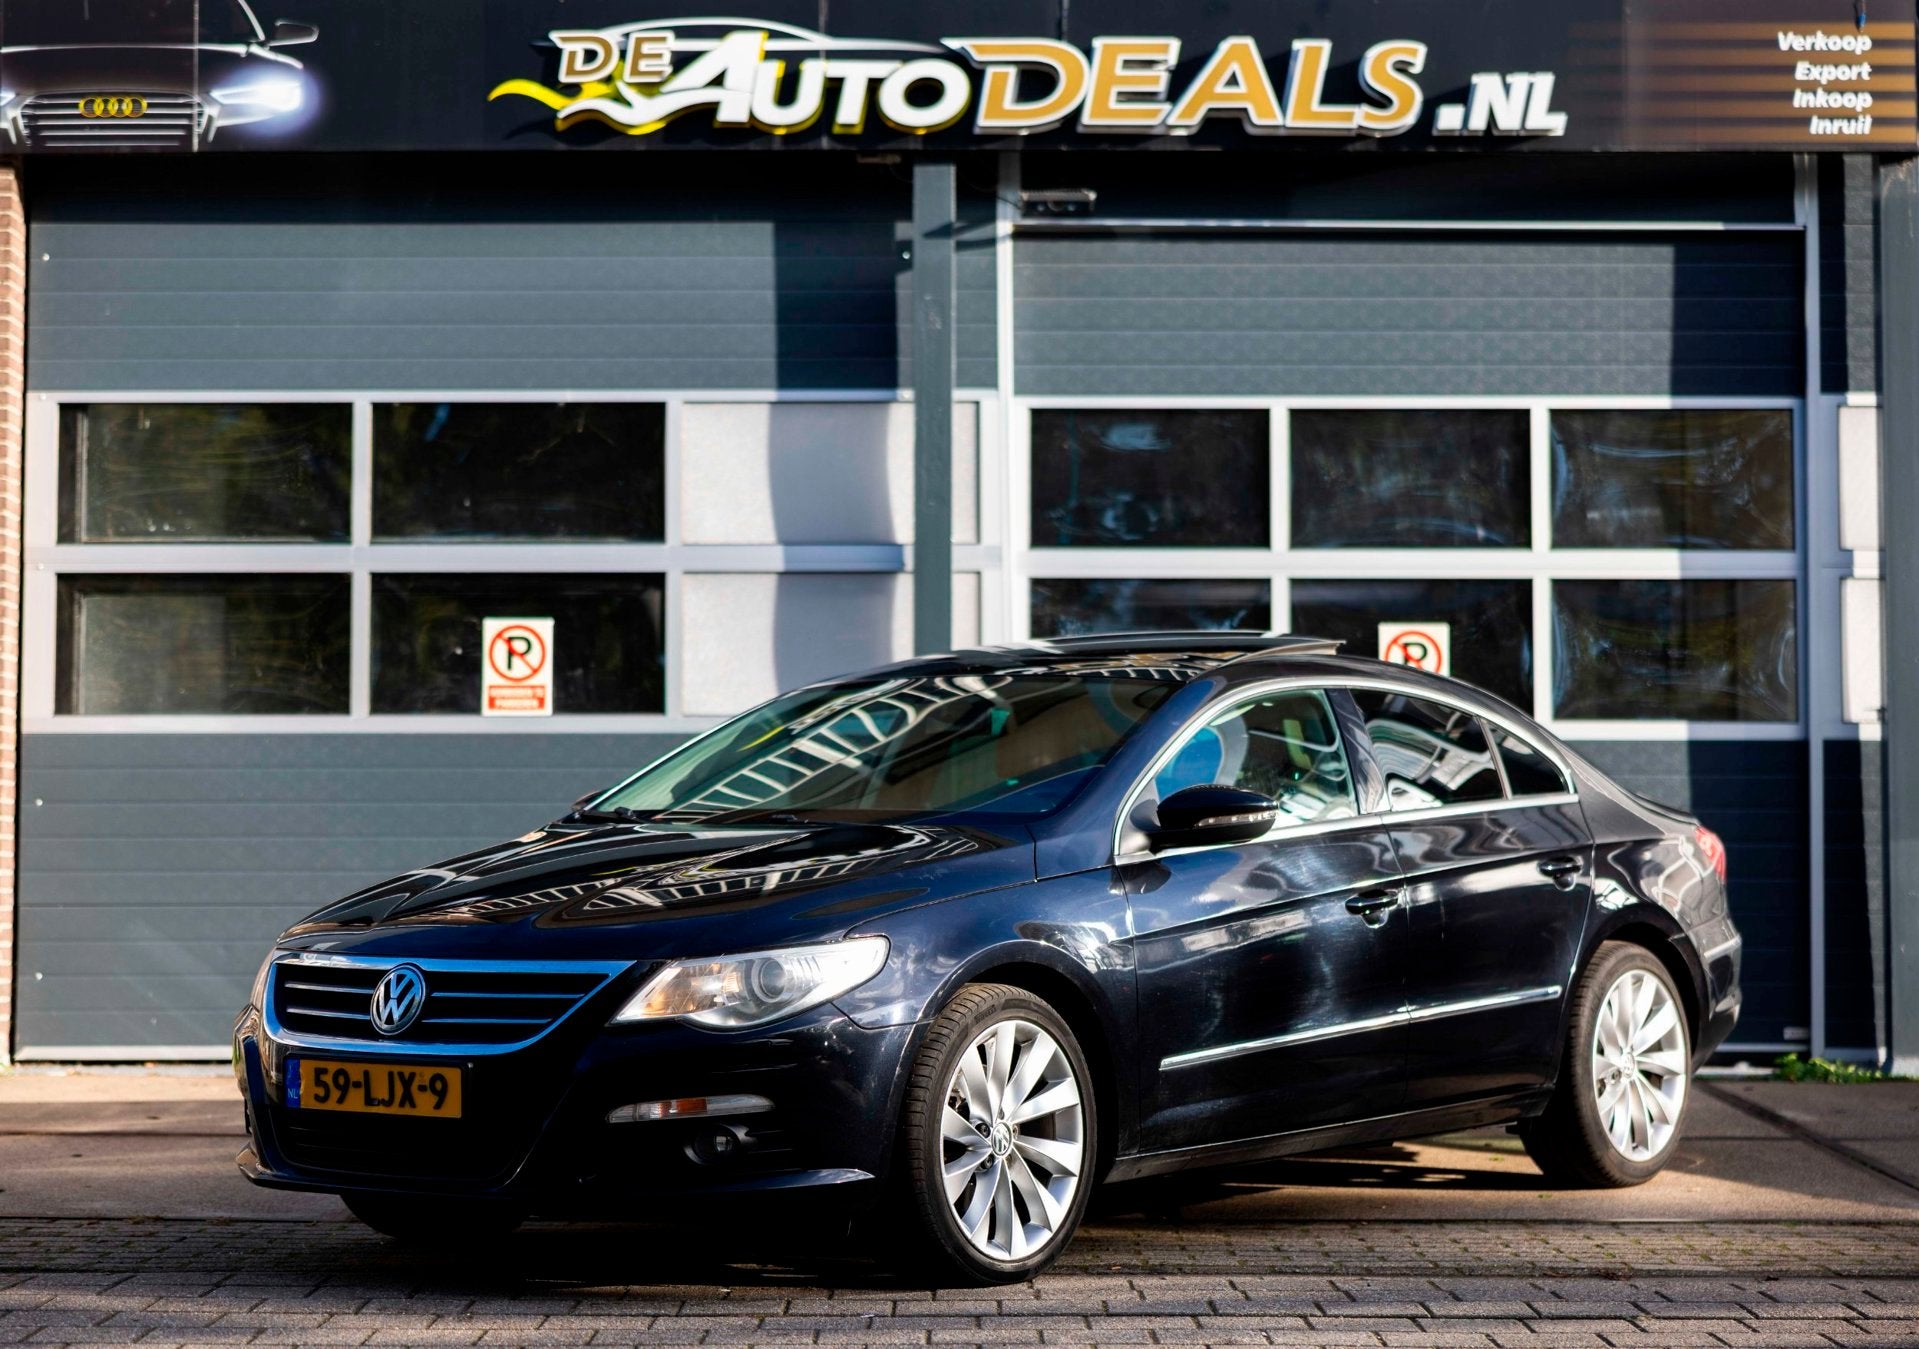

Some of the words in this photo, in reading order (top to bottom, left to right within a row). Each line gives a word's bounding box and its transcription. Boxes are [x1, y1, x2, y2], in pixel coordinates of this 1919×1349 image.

[1777, 30, 1873, 55] Verkoop
[1794, 60, 1873, 85] Export
[1792, 86, 1874, 112] Inkoop
[1809, 113, 1873, 135] Inruil
[313, 1066, 449, 1111] 59-LJX-9
